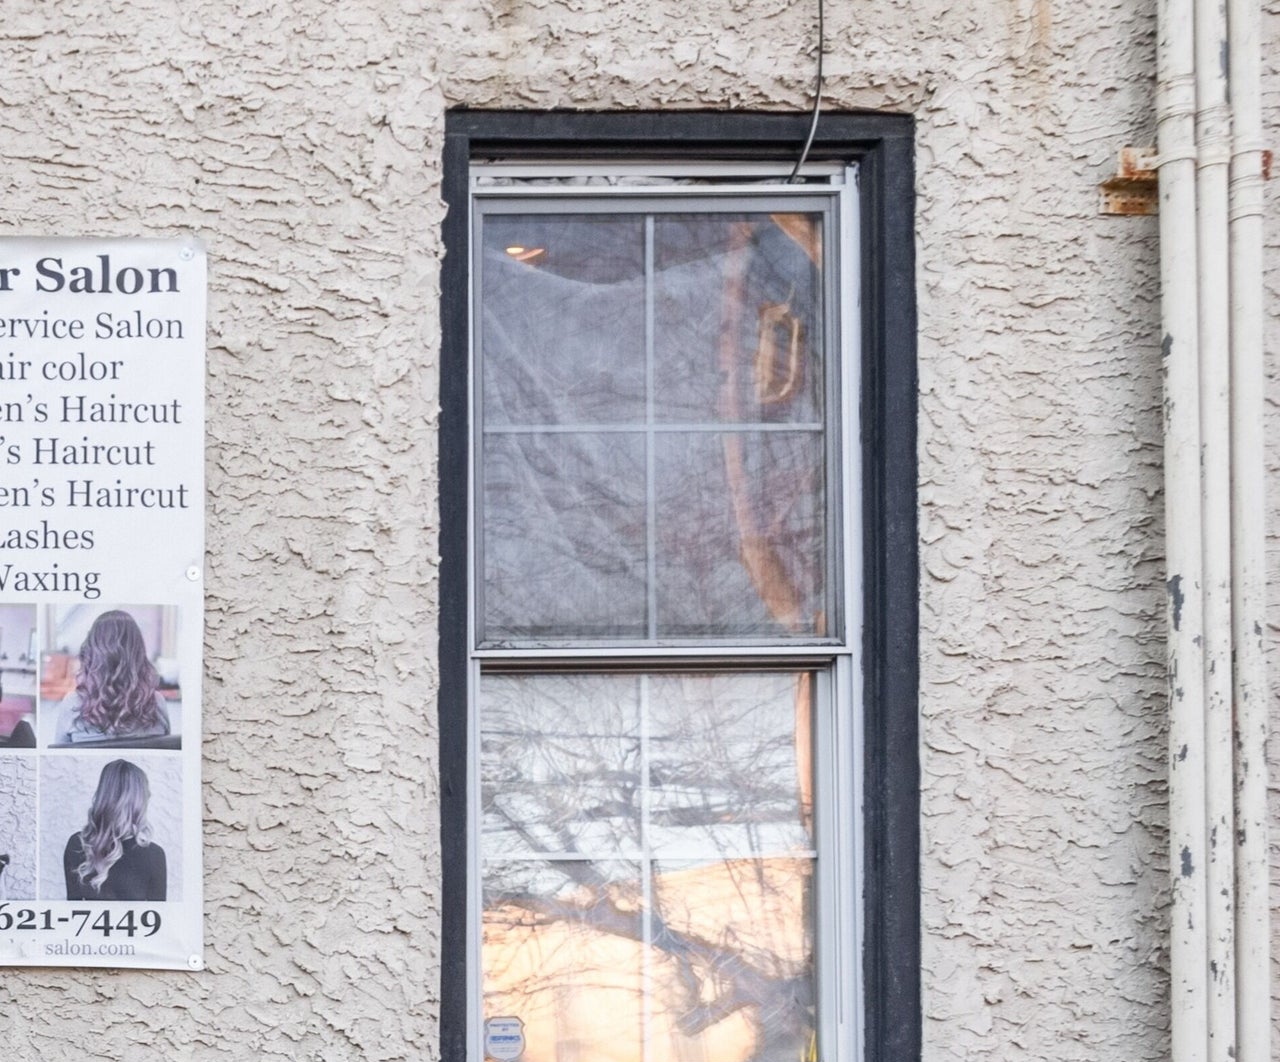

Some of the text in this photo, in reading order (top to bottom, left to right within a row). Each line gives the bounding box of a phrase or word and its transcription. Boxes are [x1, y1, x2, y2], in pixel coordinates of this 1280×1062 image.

[36, 255, 180, 294] Salon
[95, 311, 184, 339] Salon
[42, 352, 123, 381] color
[60, 395, 182, 424] Haircut
[32, 438, 155, 466] Haircut
[66, 480, 189, 508] Haircut
